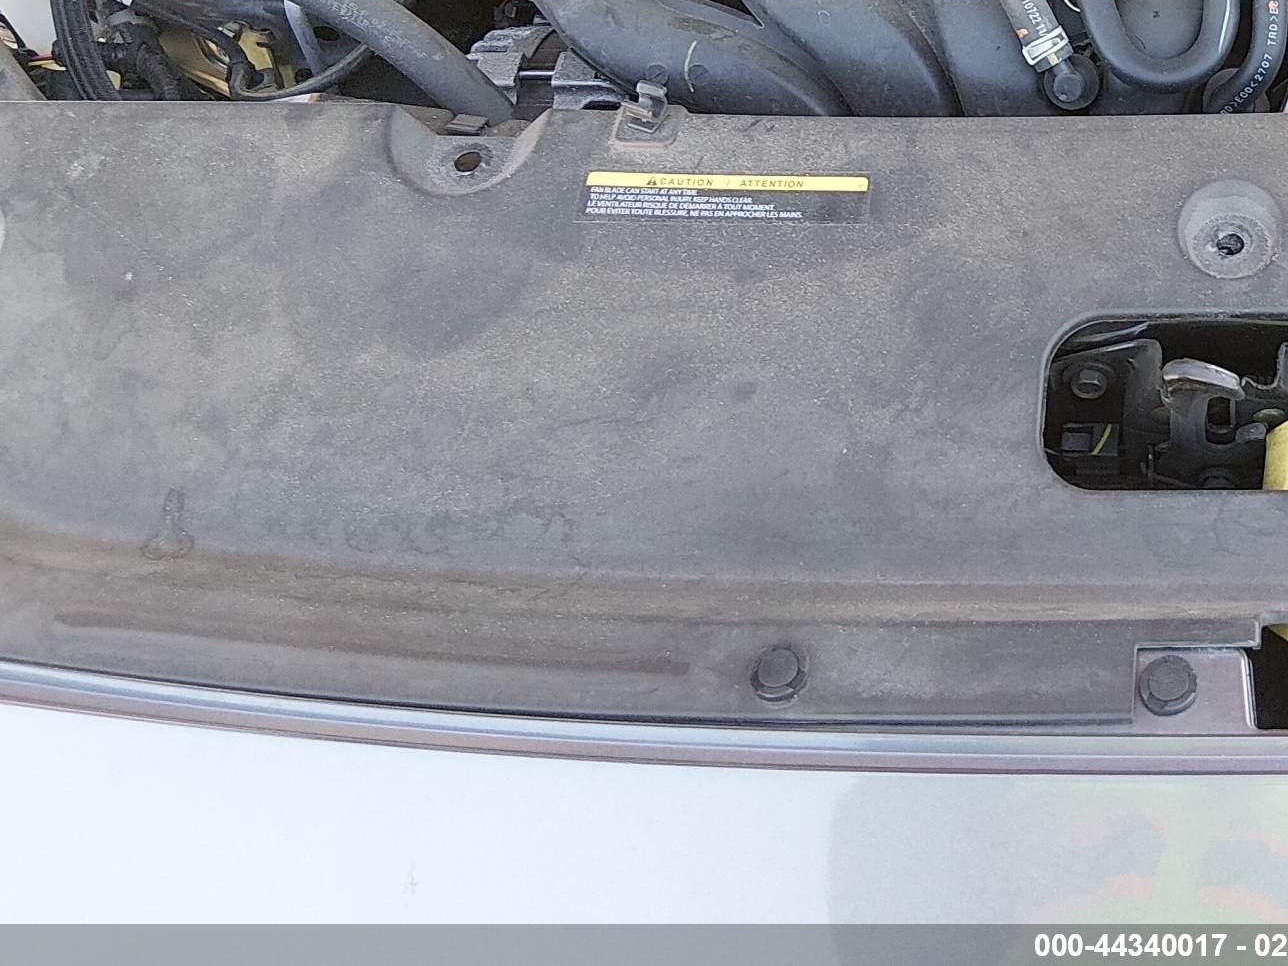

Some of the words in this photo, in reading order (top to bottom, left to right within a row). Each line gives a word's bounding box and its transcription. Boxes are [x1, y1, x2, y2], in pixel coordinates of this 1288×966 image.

[660, 177, 714, 187] CAUTION
[739, 179, 804, 188] ATTENTION
[597, 200, 642, 208] VENTILATEUR
[725, 210, 766, 218] APPROCHER
